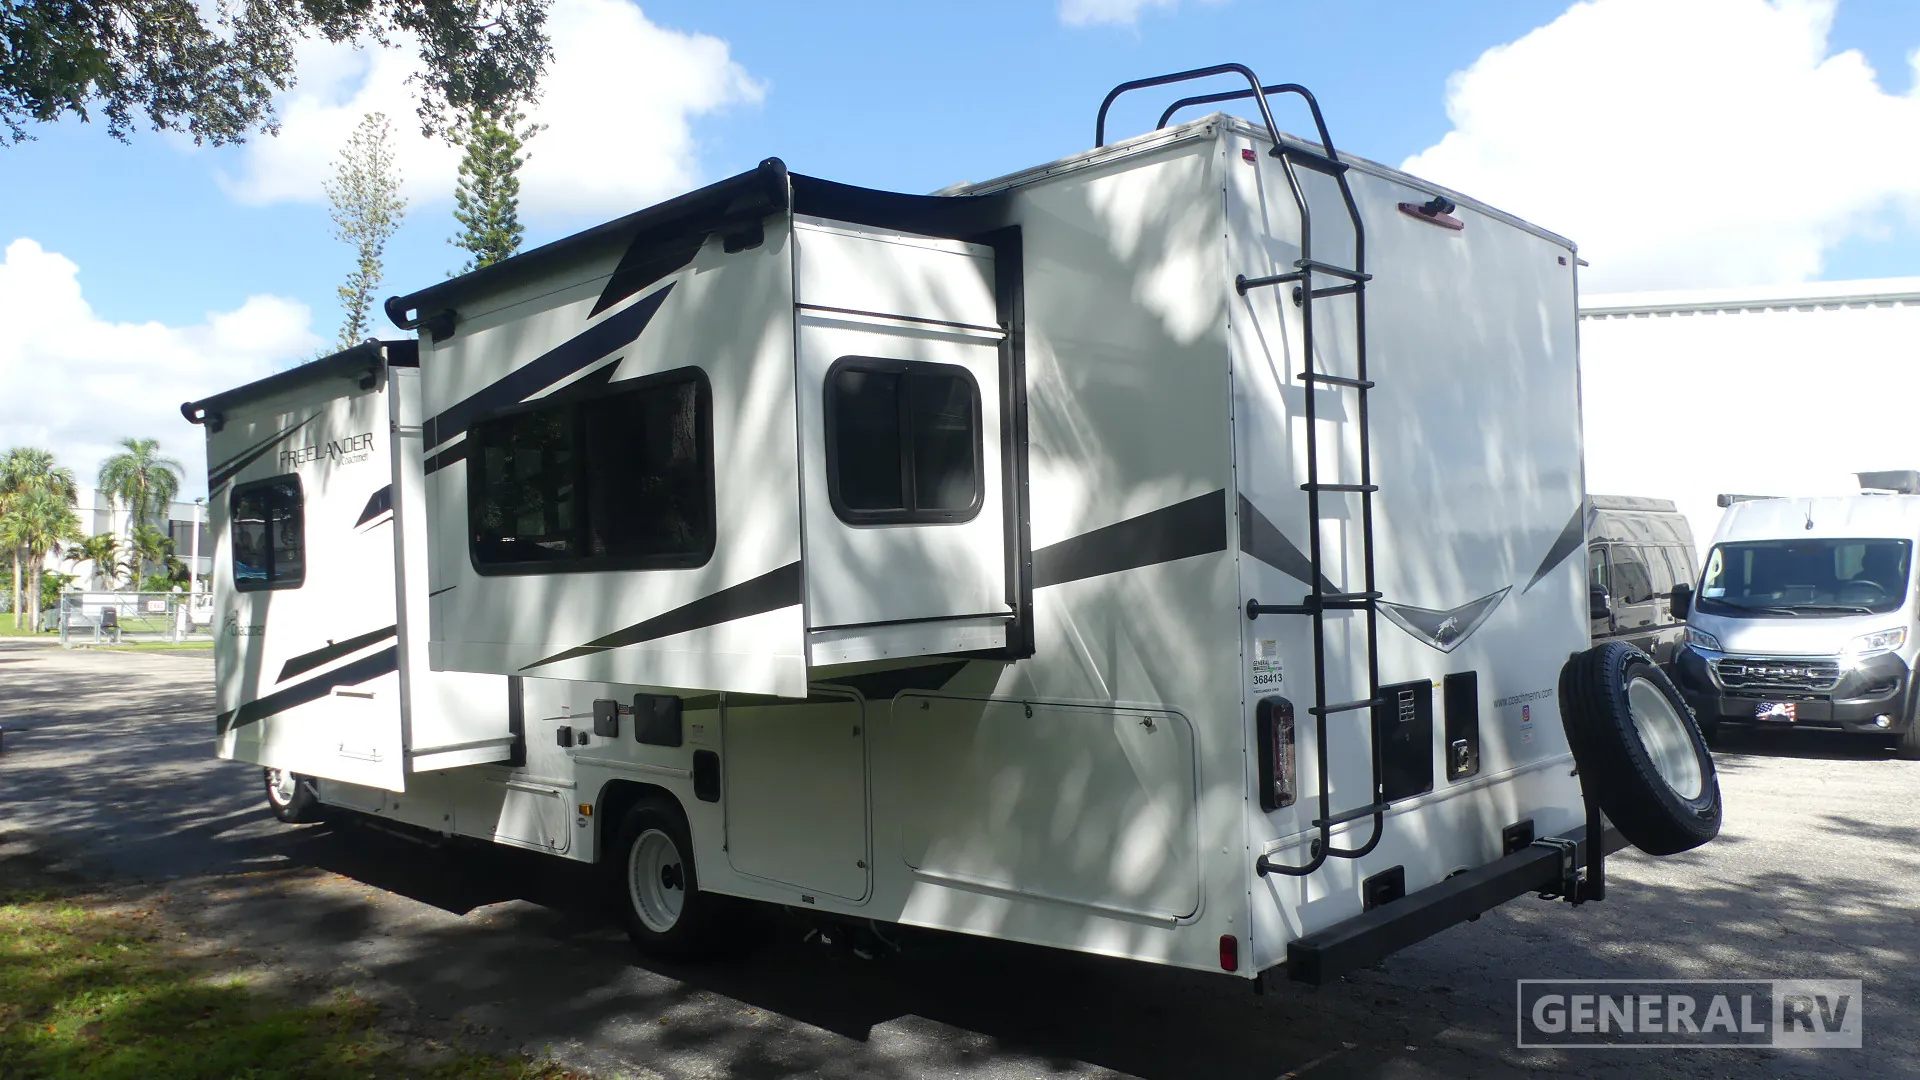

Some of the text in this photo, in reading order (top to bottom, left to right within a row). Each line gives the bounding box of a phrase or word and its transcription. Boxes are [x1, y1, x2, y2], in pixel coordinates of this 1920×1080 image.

[280, 432, 374, 468] FREELANDER
[1253, 673, 1283, 685] 368413
[1493, 688, 1553, 708] www.coachmenrv.com
